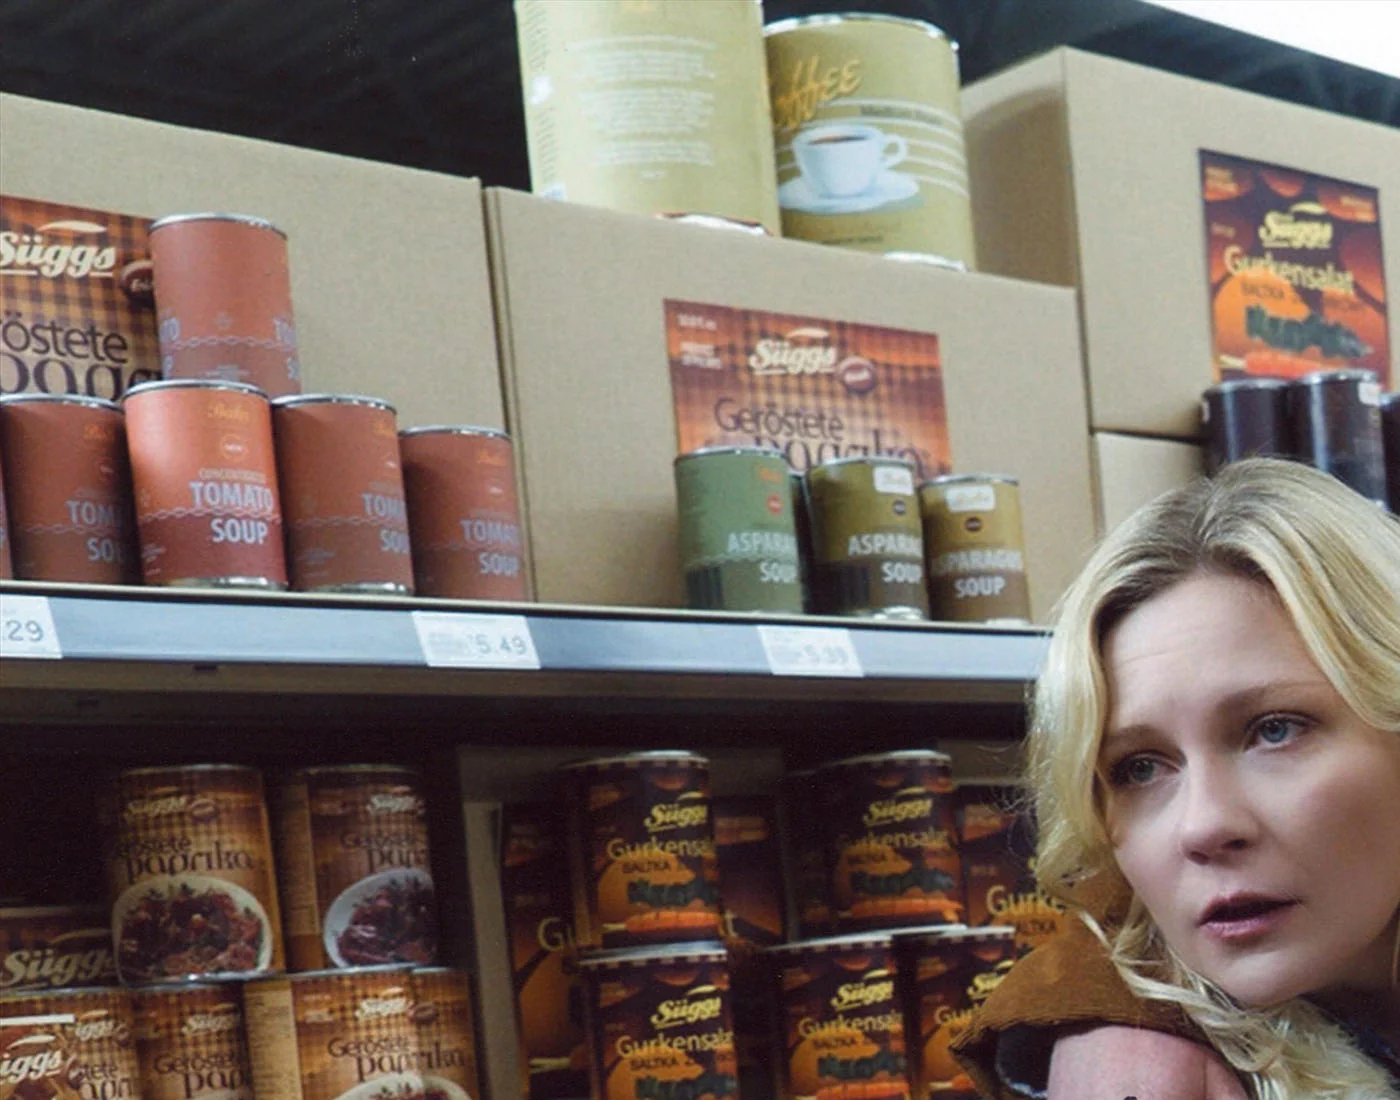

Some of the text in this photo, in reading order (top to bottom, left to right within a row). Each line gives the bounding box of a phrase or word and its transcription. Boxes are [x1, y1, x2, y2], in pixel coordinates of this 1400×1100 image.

[0, 231, 116, 277] Süggs
[1224, 246, 1353, 295] Gurkensalat
[0, 308, 128, 364] östete
[749, 338, 837, 374] Süggs
[714, 397, 844, 440] Geröstete
[189, 481, 273, 513] TOMATO
[210, 517, 268, 544] SOUP
[955, 575, 1006, 599] SOUP
[124, 841, 254, 882] paprika
[355, 1039, 465, 1083] paprika
